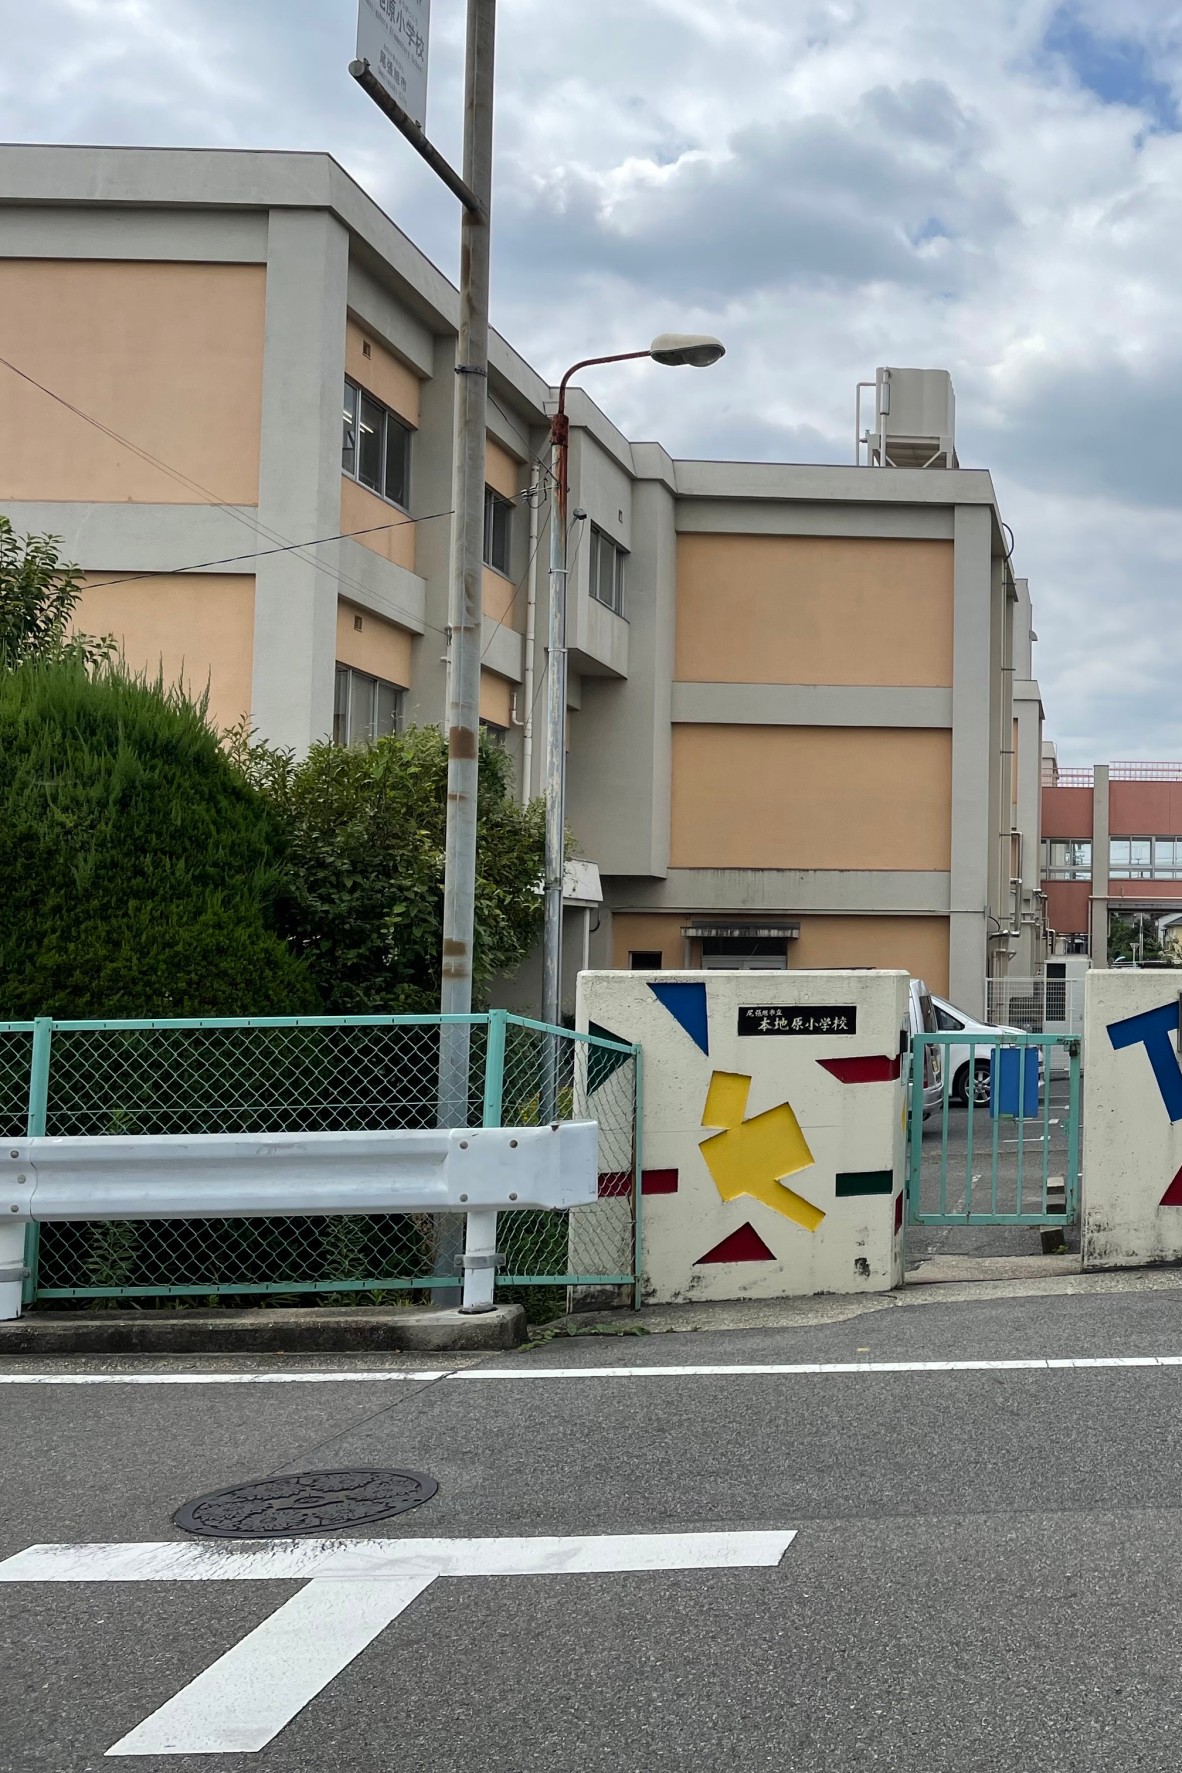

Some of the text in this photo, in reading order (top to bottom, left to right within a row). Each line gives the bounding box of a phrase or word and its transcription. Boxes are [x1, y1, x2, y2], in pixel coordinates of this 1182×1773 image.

[746, 1008, 783, 1017] 尾張旭市立
[757, 1016, 849, 1032] 本地原小学校
